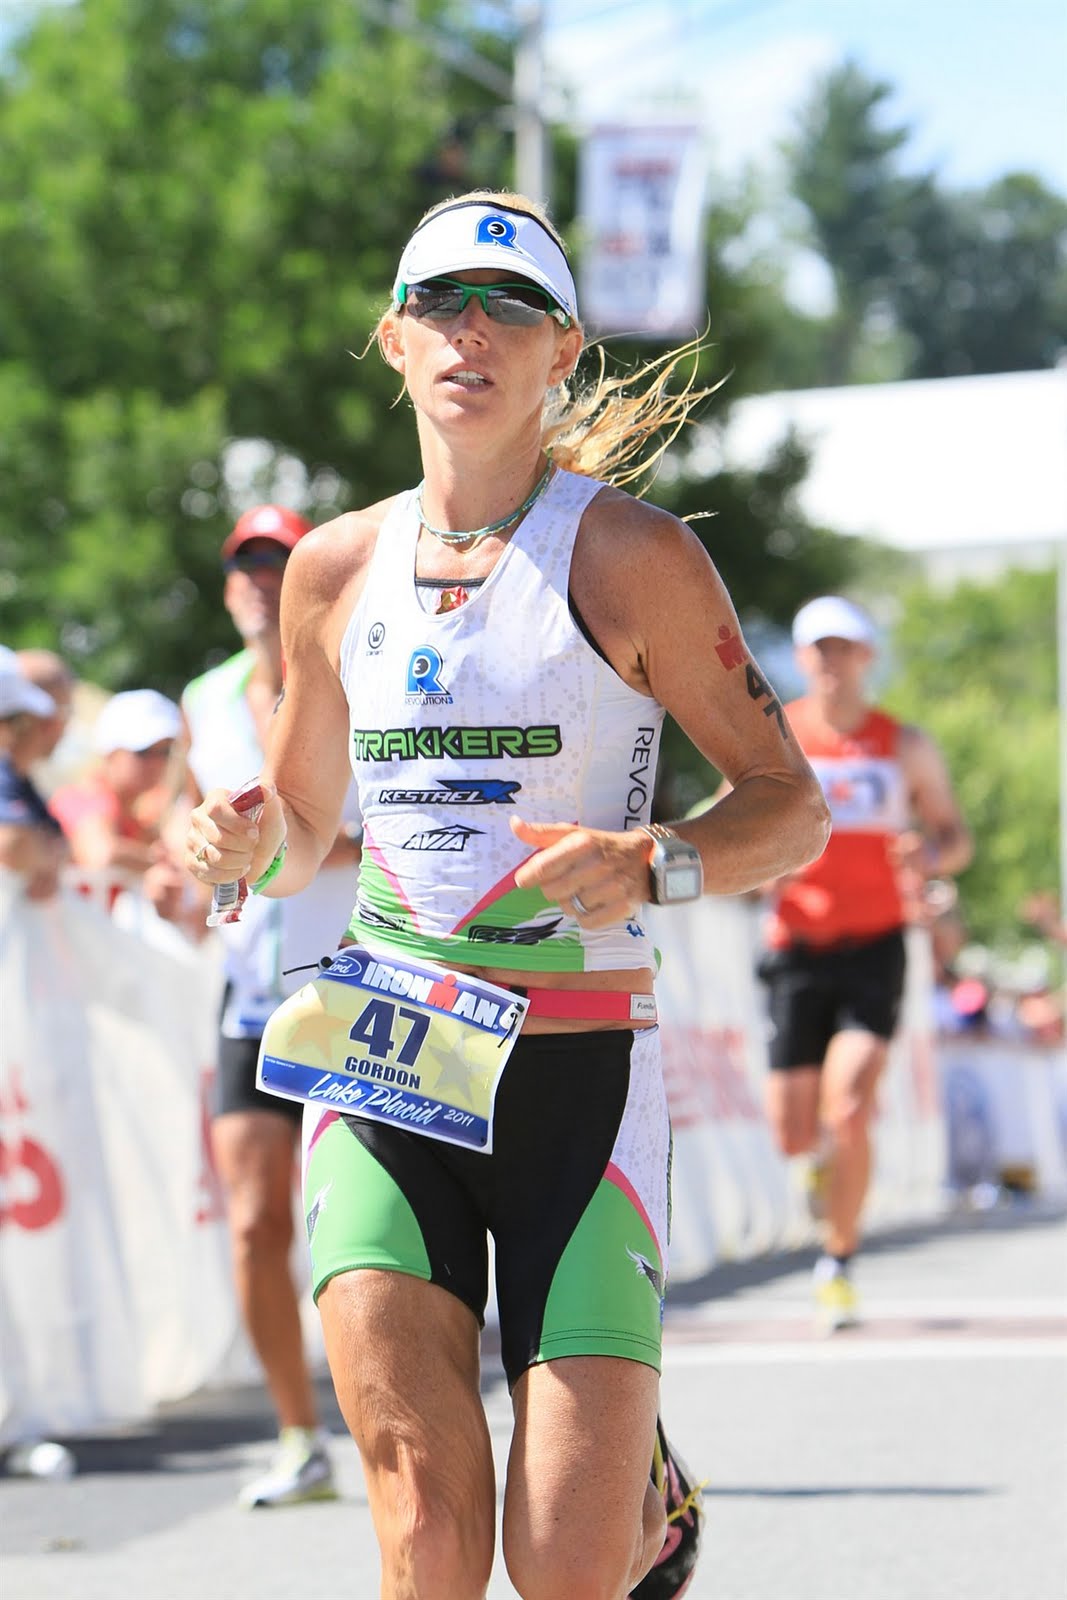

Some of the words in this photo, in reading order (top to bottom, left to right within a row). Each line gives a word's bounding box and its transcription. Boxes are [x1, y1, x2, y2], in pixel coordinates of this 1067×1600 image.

[745, 663, 788, 740] 47
[353, 725, 563, 762] TRAKKERS
[379, 789, 486, 804] KESTREL
[624, 727, 655, 830] REVOL
[401, 830, 470, 852] AVIA
[360, 960, 501, 1030] IRONMAN
[349, 998, 431, 1067] 47
[308, 1072, 366, 1105] Lake
[359, 1084, 443, 1126] Placid
[443, 1108, 476, 1128] 2011
[344, 1056, 421, 1090] GORDON
